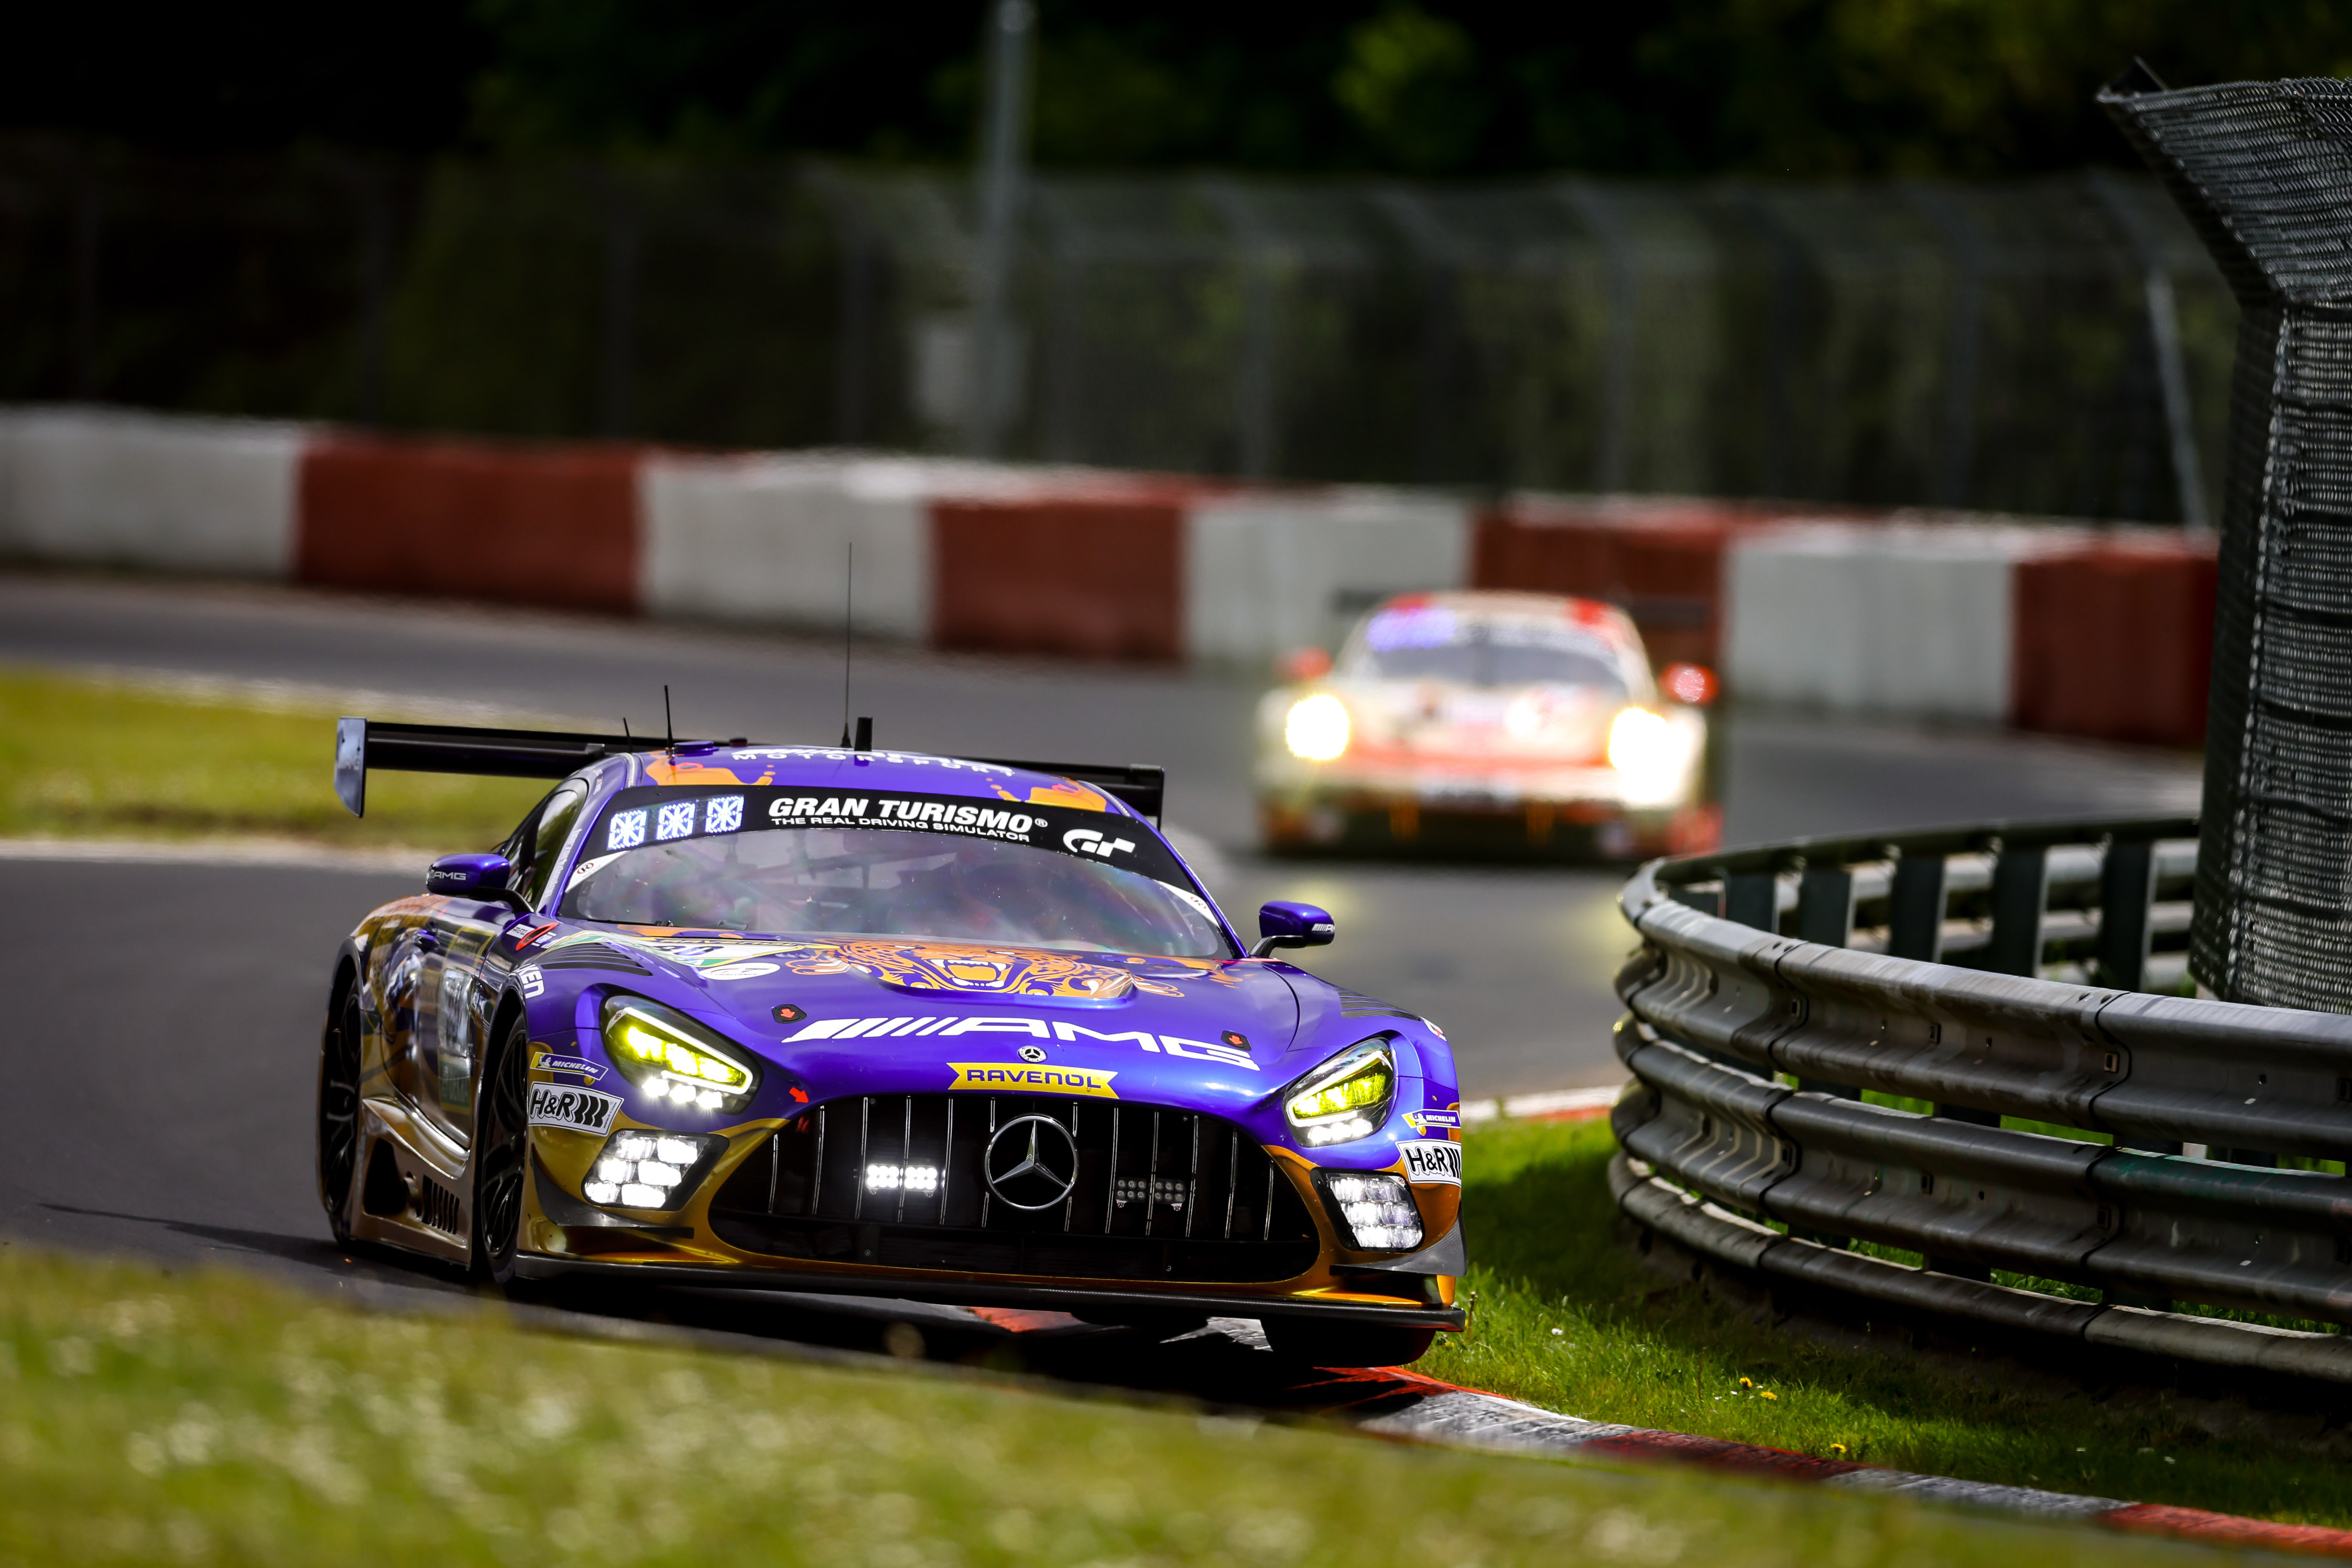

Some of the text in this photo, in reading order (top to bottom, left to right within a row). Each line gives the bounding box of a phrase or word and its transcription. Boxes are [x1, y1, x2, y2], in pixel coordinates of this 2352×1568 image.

[732, 753, 1015, 777] MOTORSPORT
[768, 797, 869, 817] GRAN
[859, 818, 929, 829] DRIVING
[933, 823, 1030, 843] SIMULATOR
[432, 871, 467, 881] AMG
[938, 1017, 1260, 1071] AMG
[552, 1060, 599, 1074] MICHELIN
[966, 1069, 1102, 1089] RAVENOL
[530, 1089, 577, 1120] H&R
[1425, 1114, 1456, 1123] MICHELIN
[1404, 1147, 1451, 1174] H&R
